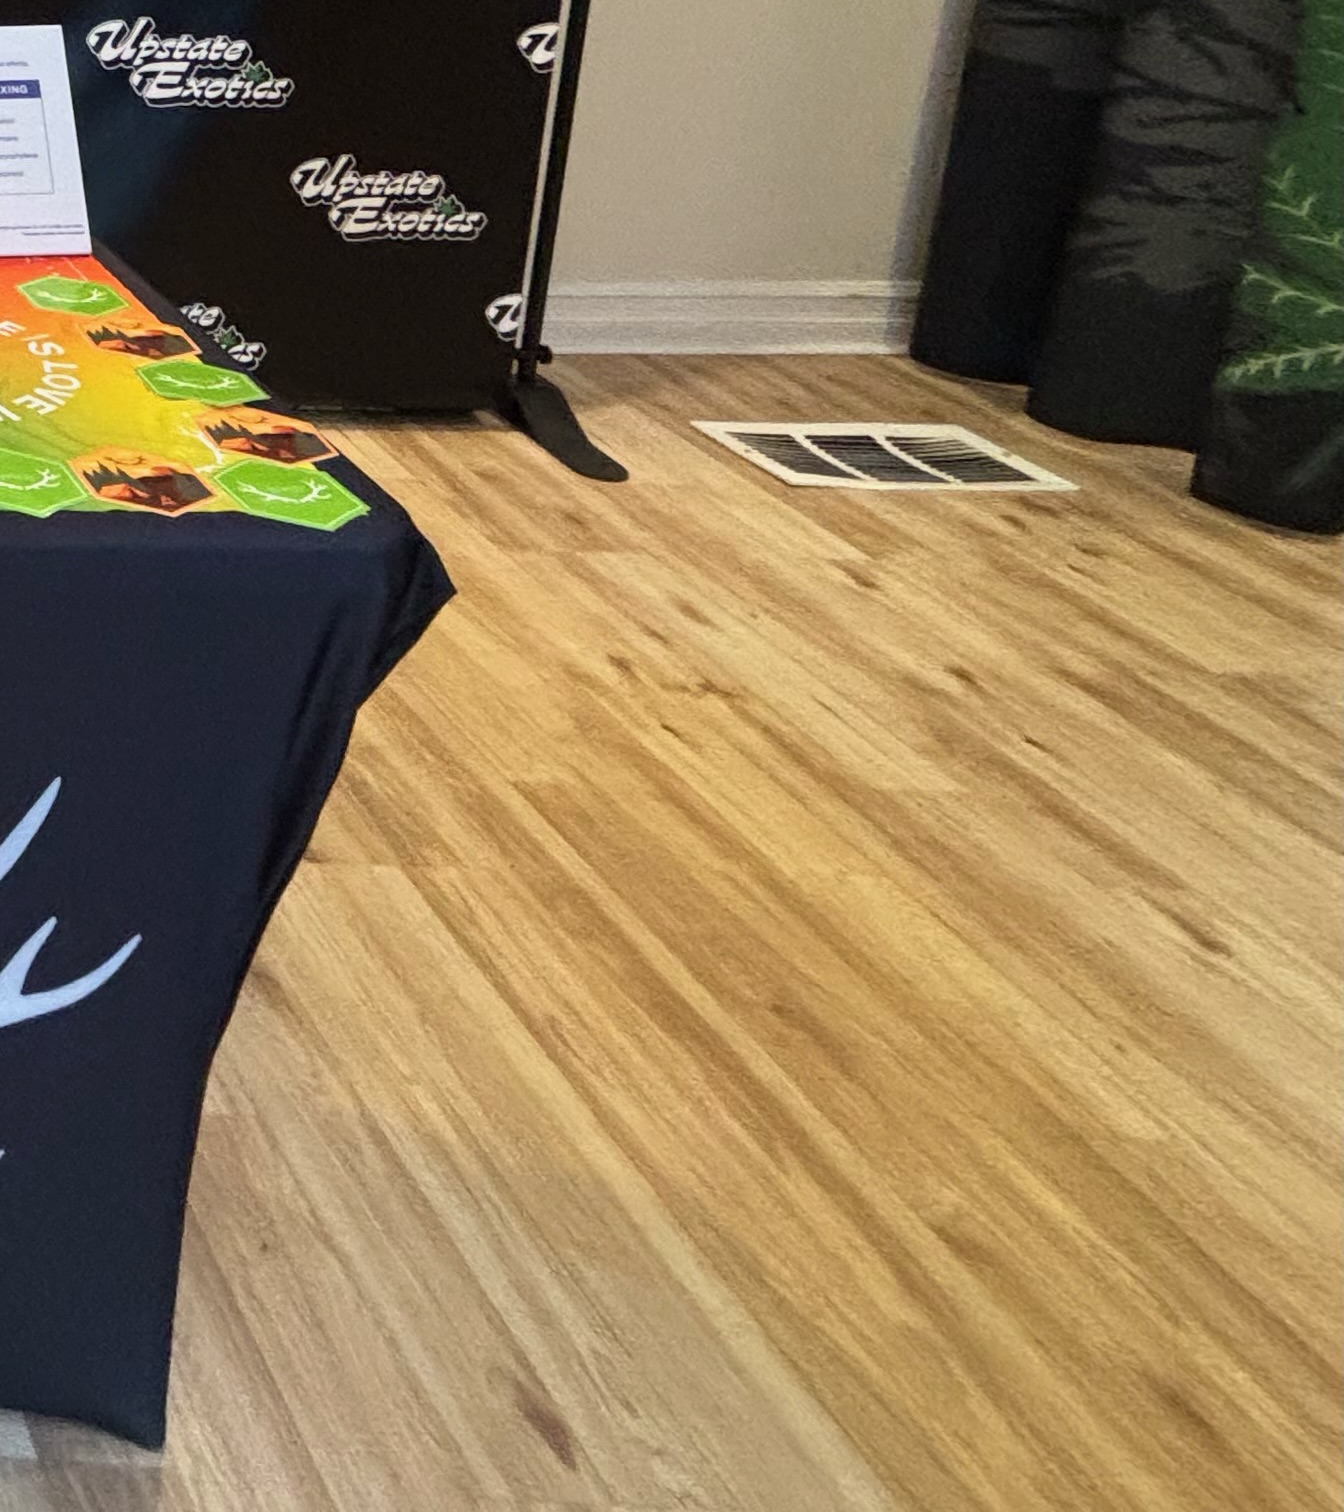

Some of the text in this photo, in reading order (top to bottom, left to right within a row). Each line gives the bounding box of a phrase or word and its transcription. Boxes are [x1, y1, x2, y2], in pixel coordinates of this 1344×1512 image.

[88, 17, 249, 70] Upstate
[129, 60, 293, 105] Exotics
[293, 154, 445, 206] Upstate
[331, 195, 486, 239] Exotics
[12, 360, 82, 416] LOVE
